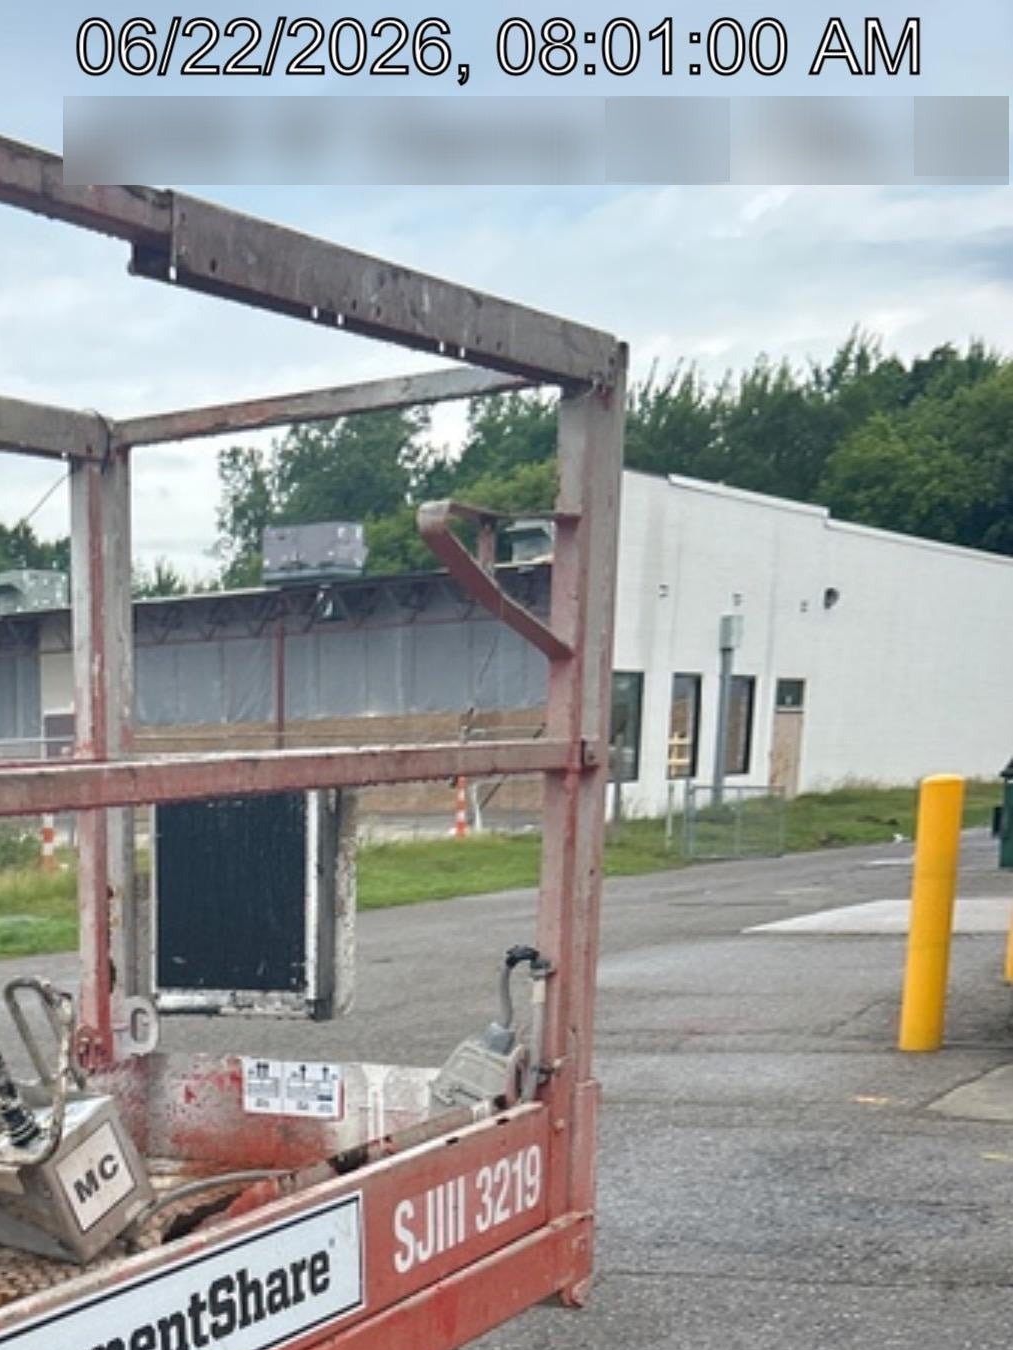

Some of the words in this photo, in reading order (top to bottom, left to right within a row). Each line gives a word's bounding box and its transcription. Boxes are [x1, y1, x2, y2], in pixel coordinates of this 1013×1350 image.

[74, 1154, 119, 1204] MC
[394, 1175, 466, 1274] SJIII
[475, 1145, 541, 1234] 3219
